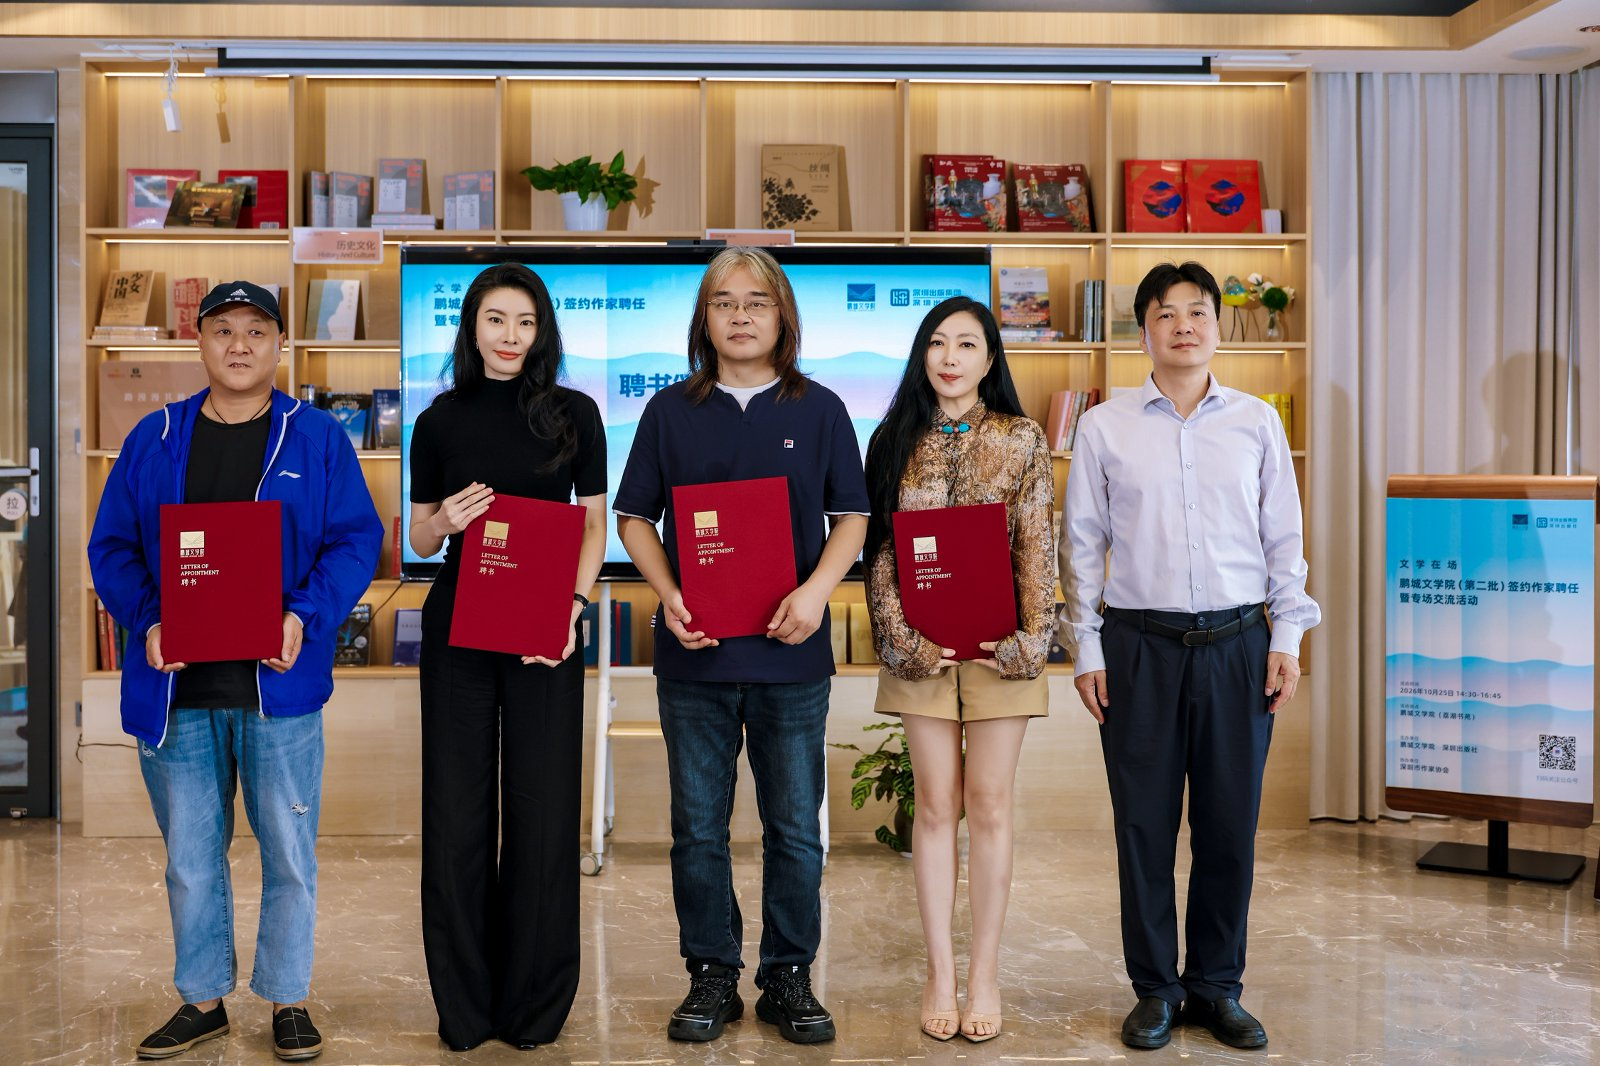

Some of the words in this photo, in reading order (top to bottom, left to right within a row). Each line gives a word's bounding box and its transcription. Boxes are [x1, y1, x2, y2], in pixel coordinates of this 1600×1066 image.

[337, 240, 376, 250] 历史文化
[6, 497, 20, 509] 拉
[481, 552, 501, 560] LETTER
[697, 548, 735, 556] APPOINTMENT
[480, 559, 518, 569] APPOINTMENT
[699, 557, 714, 565] 聘书
[1400, 559, 1457, 570] 文学在场
[479, 567, 495, 575] 聘书
[181, 578, 197, 586] 聘书
[916, 582, 932, 590] 聘书
[1400, 578, 1580, 594] 鹏城文学院（第二批）签约作家聘任
[1400, 592, 1478, 606] 暨专场交流活动
[1456, 690, 1502, 699] 14:30-16:45
[1400, 763, 1449, 774] 深圳市作家协会
